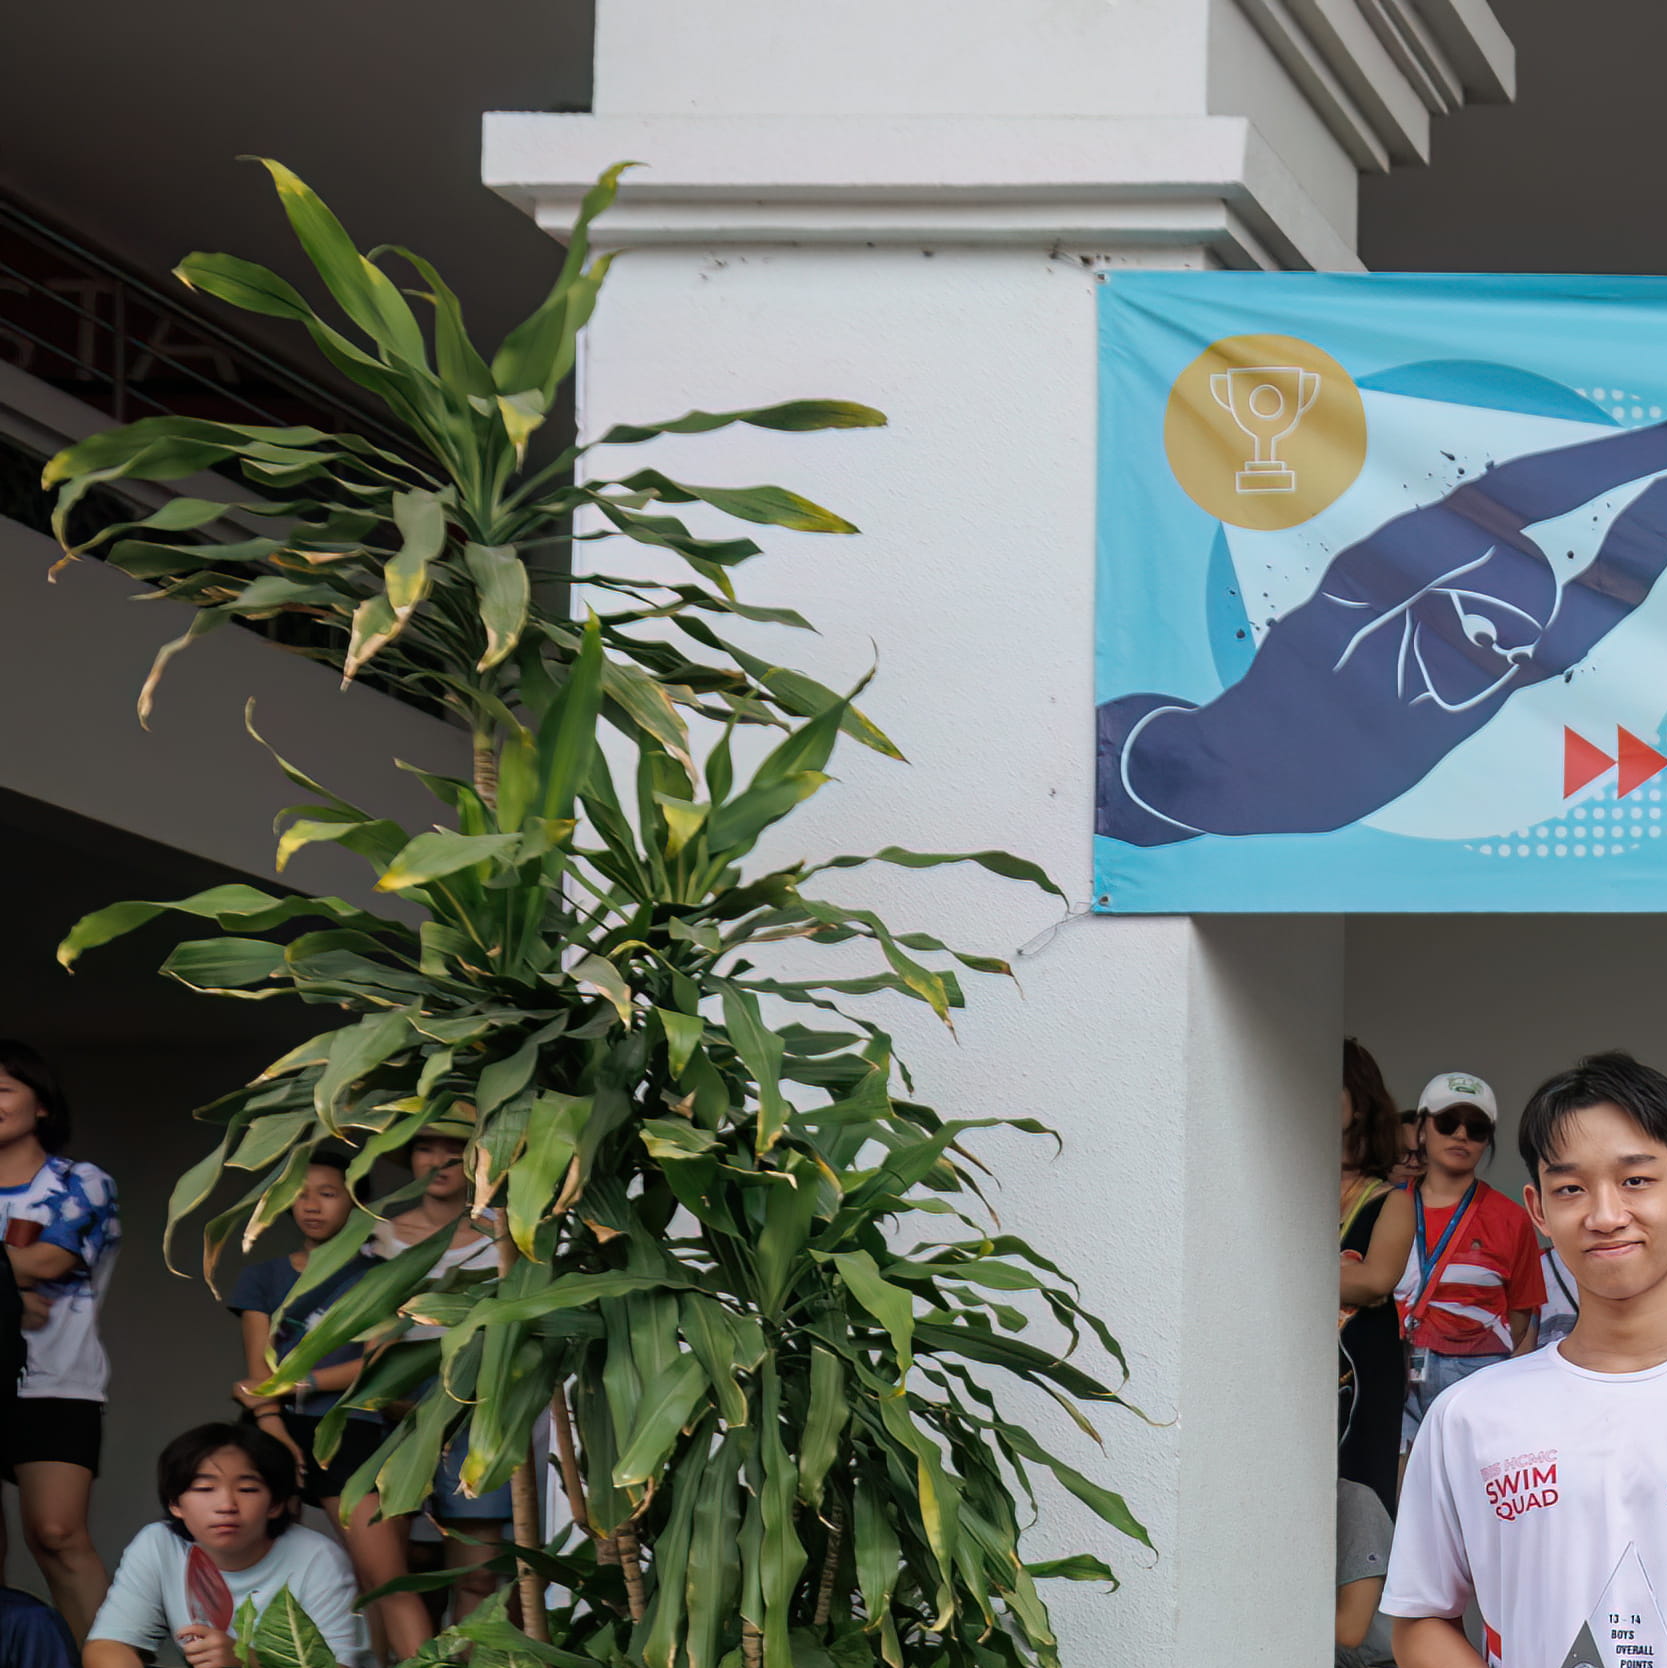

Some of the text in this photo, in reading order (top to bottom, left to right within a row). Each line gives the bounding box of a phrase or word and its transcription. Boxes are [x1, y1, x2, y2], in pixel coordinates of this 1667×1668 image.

[1486, 1464, 1557, 1505] SWIM
[1496, 1489, 1559, 1521] QUAD
[1609, 1614, 1619, 1624] 13
[1631, 1614, 1641, 1624] 14
[1611, 1629, 1635, 1640] BOYS
[1615, 1645, 1654, 1656] OVERALL
